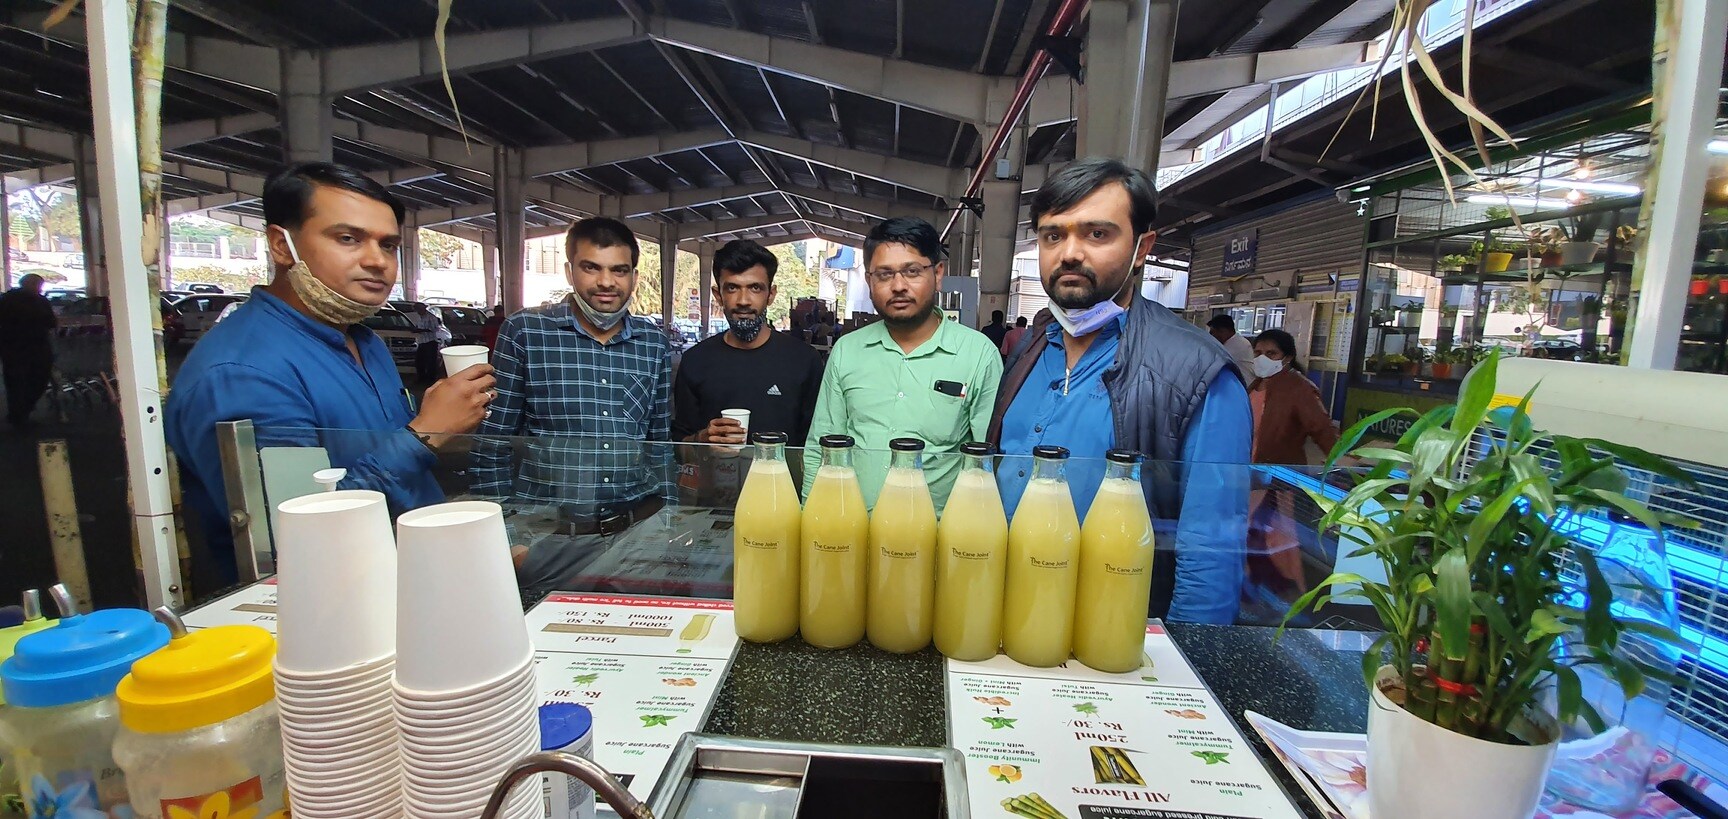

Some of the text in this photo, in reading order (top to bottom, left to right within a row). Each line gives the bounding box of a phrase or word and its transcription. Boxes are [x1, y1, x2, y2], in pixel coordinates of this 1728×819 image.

[1231, 237, 1248, 254] Exit
[1358, 412, 1412, 436] URES
[881, 547, 890, 555] The
[544, 689, 575, 697] 30/-
[1062, 719, 1122, 730] Rs. 30/-
[1074, 732, 1128, 743] 250ml
[1001, 755, 1040, 763] Immunity
[1072, 787, 1170, 802] All Flavors
[1114, 808, 1162, 817] sugarcane
